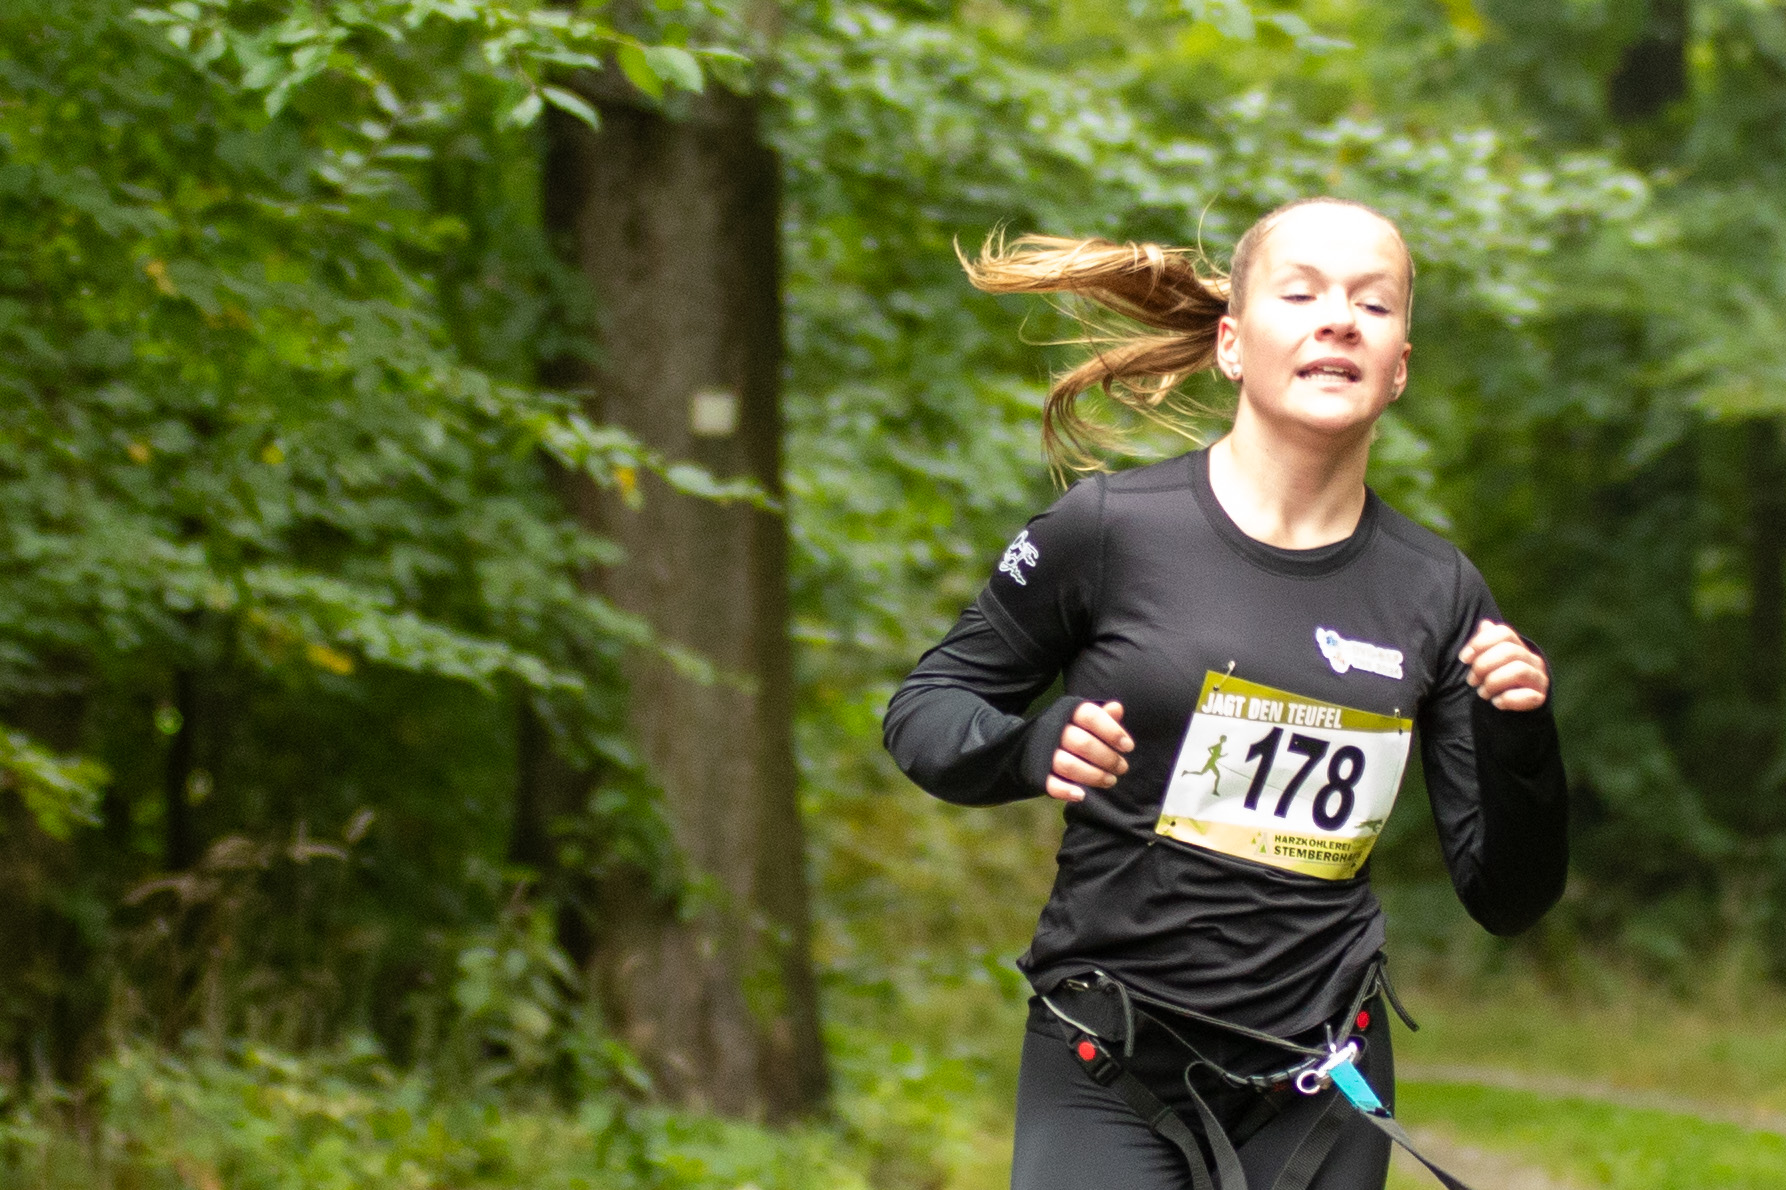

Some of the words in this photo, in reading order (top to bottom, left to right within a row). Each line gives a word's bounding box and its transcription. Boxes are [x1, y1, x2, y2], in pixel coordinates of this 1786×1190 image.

[1201, 692, 1246, 718] JAGT
[1247, 697, 1284, 722] DEN
[1287, 702, 1342, 729] TEUFEL
[1244, 726, 1366, 832] 178
